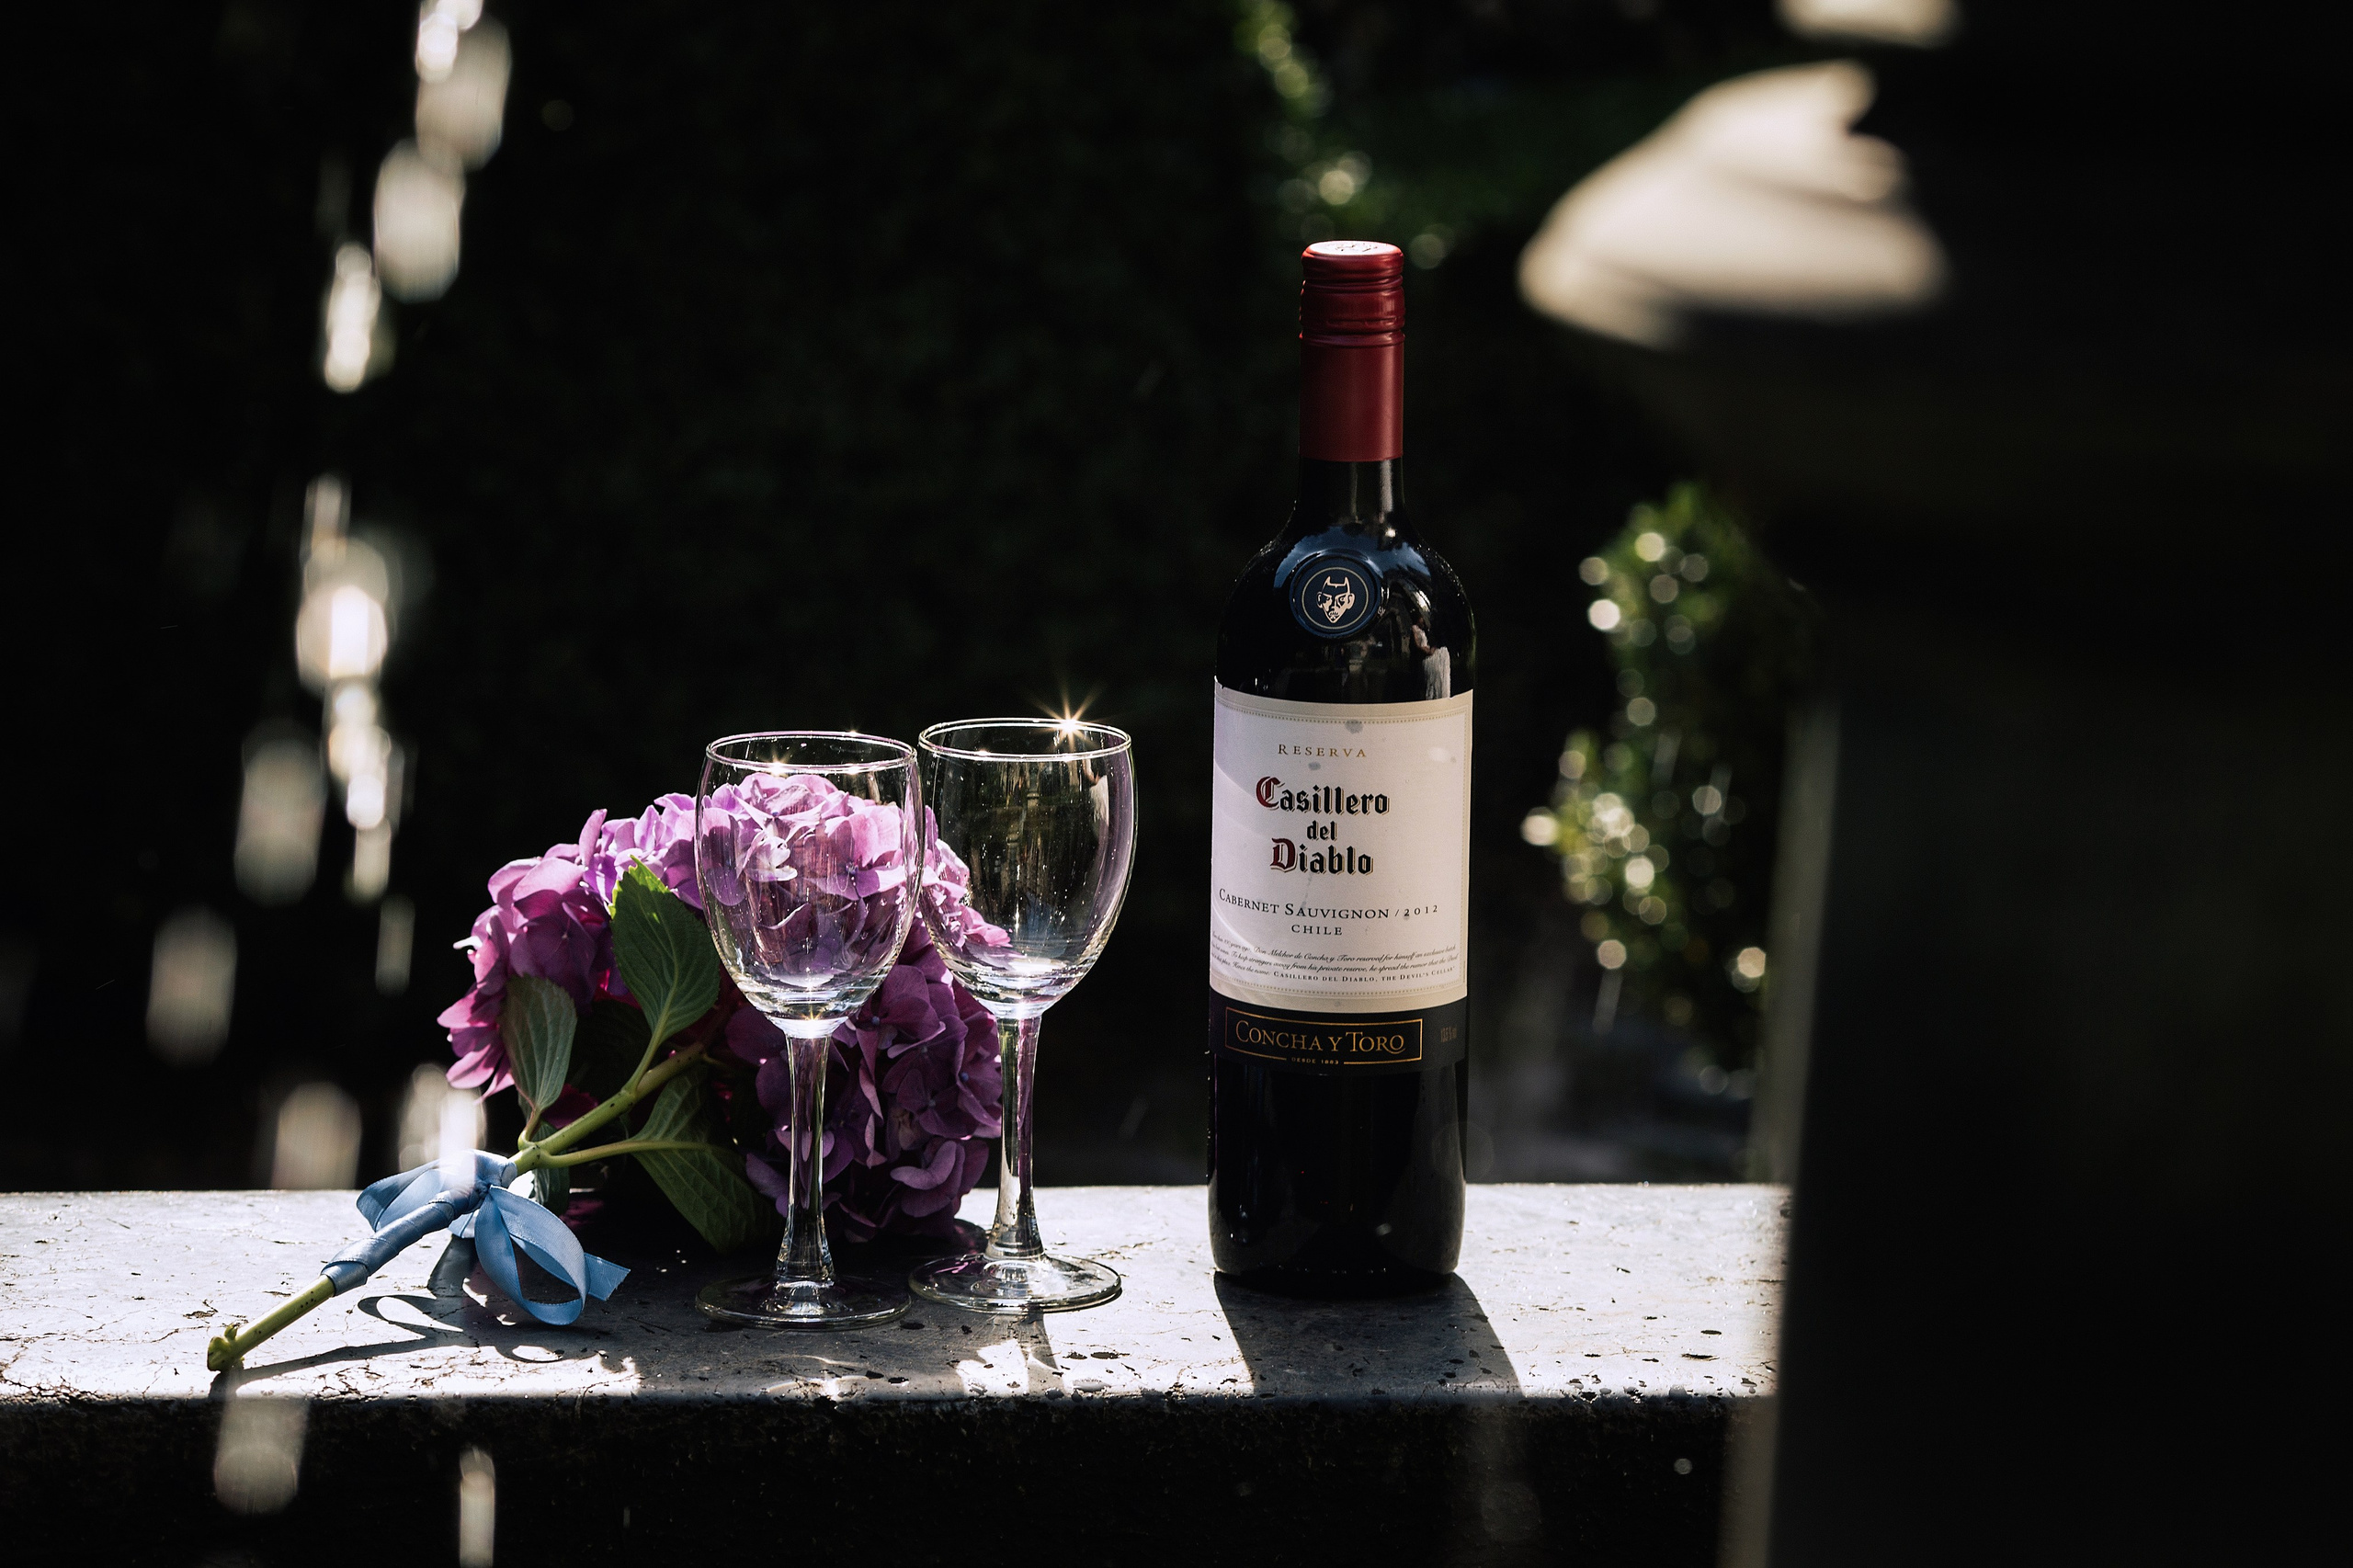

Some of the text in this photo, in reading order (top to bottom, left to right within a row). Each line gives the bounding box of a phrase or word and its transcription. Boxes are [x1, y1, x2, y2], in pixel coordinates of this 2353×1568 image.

[1278, 744, 1367, 758] RESERVA
[1256, 776, 1390, 816] Casillero
[1306, 820, 1338, 842] del
[1269, 837, 1374, 876] Diablo
[1219, 888, 1279, 914] CABERNET
[1284, 903, 1390, 919] SAUVIGNON
[1404, 904, 1438, 917] 2012
[1290, 924, 1343, 936] CHILE
[1268, 949, 1293, 959] Melchor
[1303, 952, 1328, 962] Concha
[1356, 953, 1385, 962] reserved
[1379, 953, 1393, 963] for
[1393, 951, 1417, 961] himself
[1248, 957, 1272, 967] strangers
[1288, 961, 1307, 971] from
[1307, 963, 1317, 971] his
[1316, 964, 1342, 973] private
[1378, 962, 1402, 974] spread
[1400, 962, 1409, 971] the
[1273, 971, 1319, 982] CASILLERO
[1235, 1019, 1406, 1055] CONCHA Y TORO
[1290, 1056, 1316, 1064] DESDE
